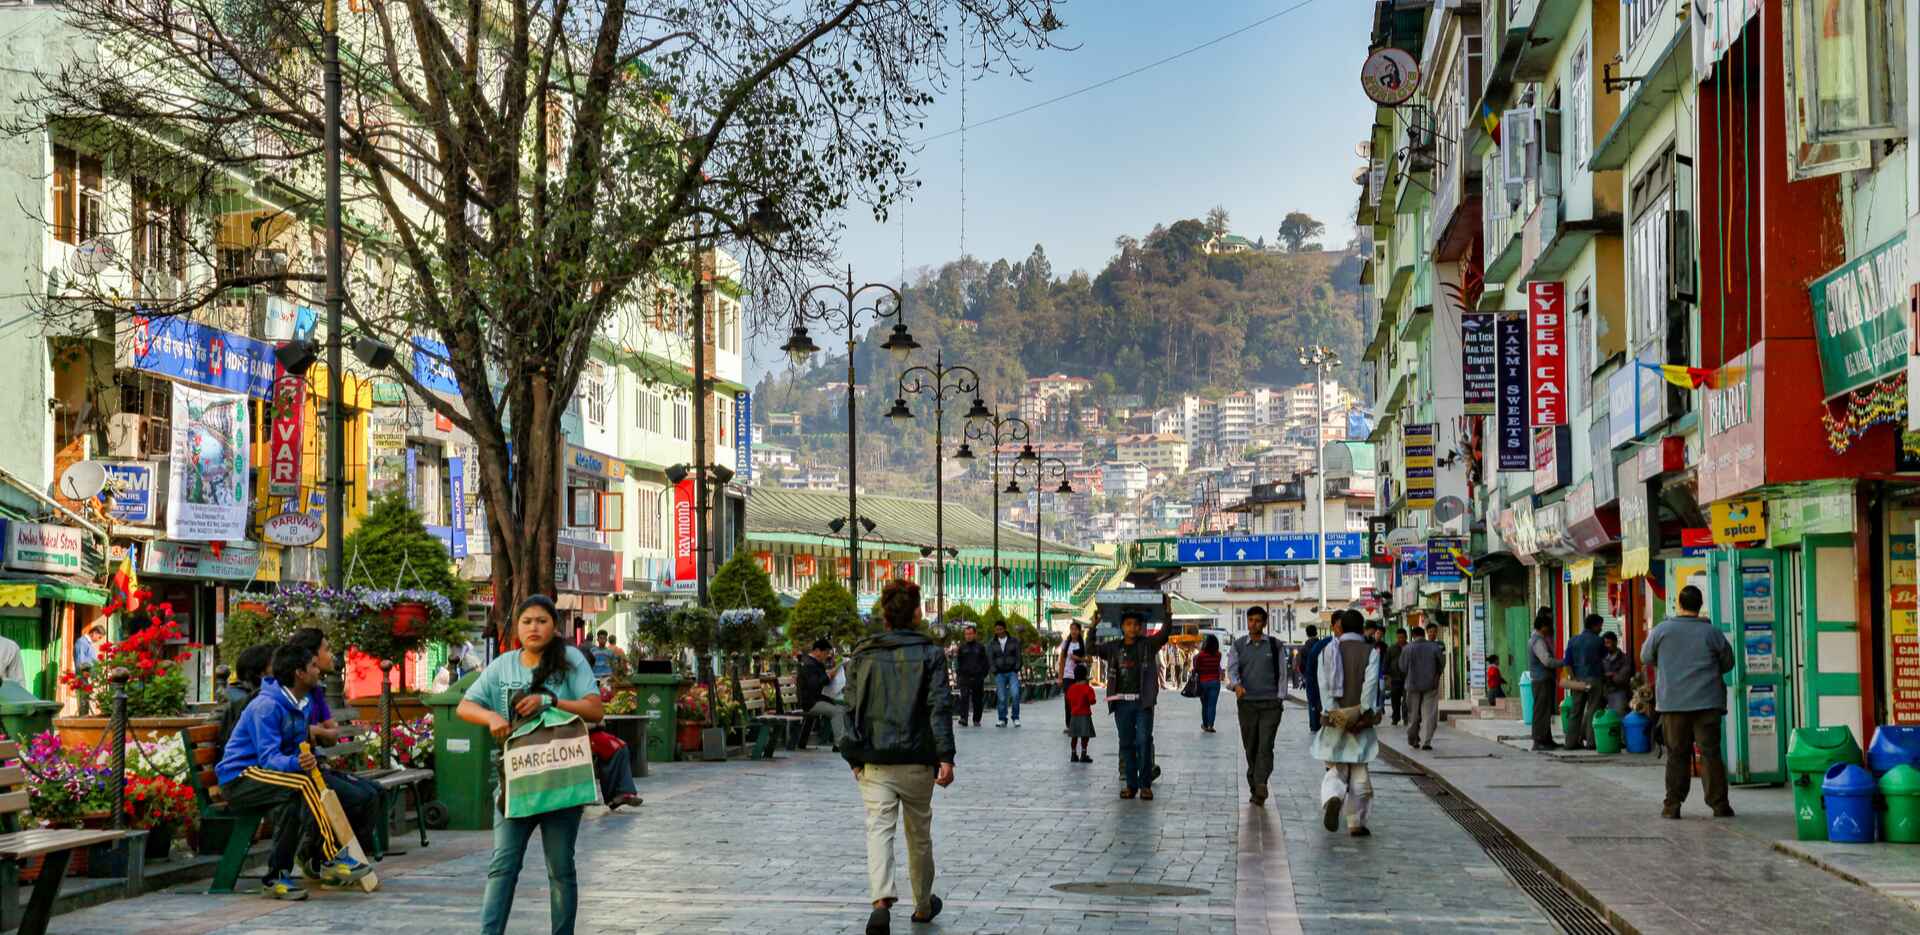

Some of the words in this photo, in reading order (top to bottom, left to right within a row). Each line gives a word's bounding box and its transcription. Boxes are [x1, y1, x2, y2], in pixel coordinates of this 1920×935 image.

[1536, 284, 1559, 356] CYBER
[225, 351, 248, 374] HDFC
[251, 359, 275, 382] BANK
[1505, 324, 1520, 377] LAXMI
[1506, 385, 1521, 447] SWEETS
[1710, 382, 1746, 437] BHARAT
[271, 516, 317, 532] PARIVAR
[1374, 522, 1386, 554] BAG
[1724, 523, 1756, 537] spice
[511, 744, 585, 772] BAARCELONA
